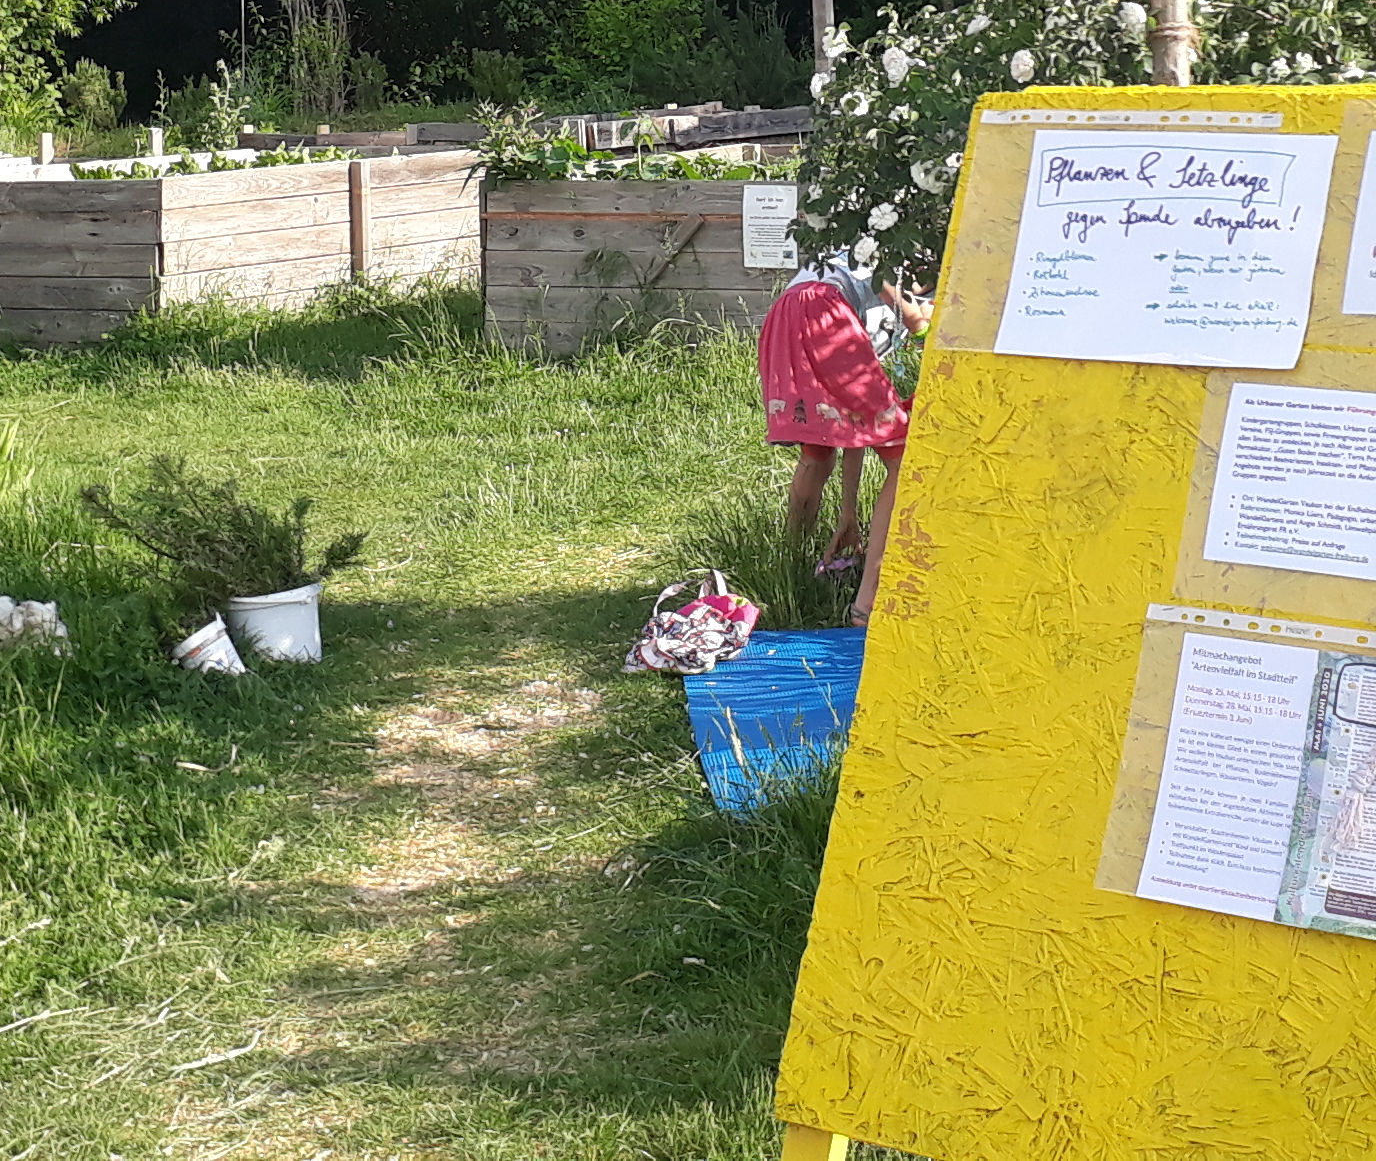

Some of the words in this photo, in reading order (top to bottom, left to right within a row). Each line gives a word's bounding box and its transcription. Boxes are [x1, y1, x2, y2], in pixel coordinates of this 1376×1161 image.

[1045, 157, 1129, 197] Pflanzen
[1137, 152, 1161, 188] &
[1169, 156, 1270, 208] Setzlinge
[1062, 211, 1106, 243] gegen
[1192, 647, 1261, 665] Mitmachangebot
[1246, 669, 1256, 678] im
[1314, 730, 1322, 751] MAI
[1318, 699, 1326, 720] JUNI
